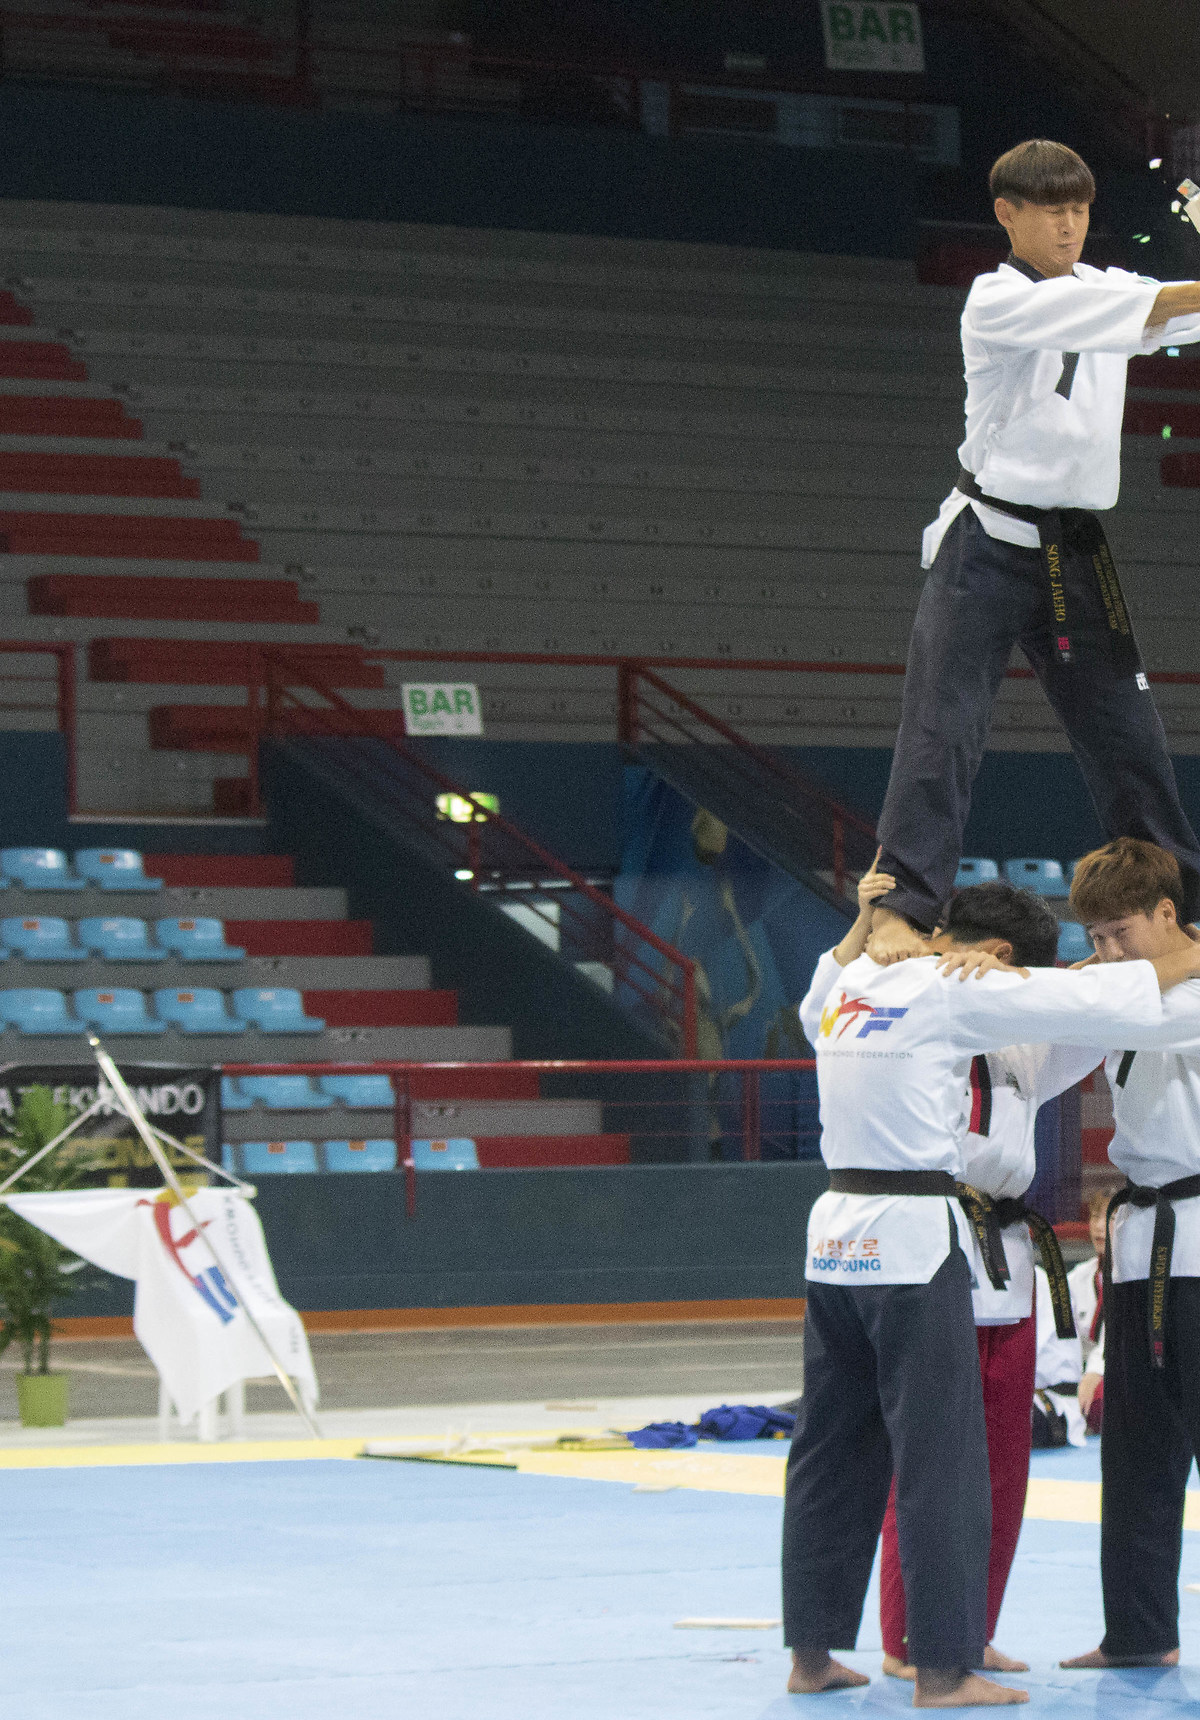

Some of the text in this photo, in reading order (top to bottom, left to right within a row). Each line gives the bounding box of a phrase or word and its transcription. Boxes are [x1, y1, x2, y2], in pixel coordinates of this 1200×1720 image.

[828, 5, 916, 43] BAR
[1046, 544, 1066, 622] SONG JAEHO
[409, 689, 474, 716] BAR
[856, 1050, 913, 1059] FEDERATION
